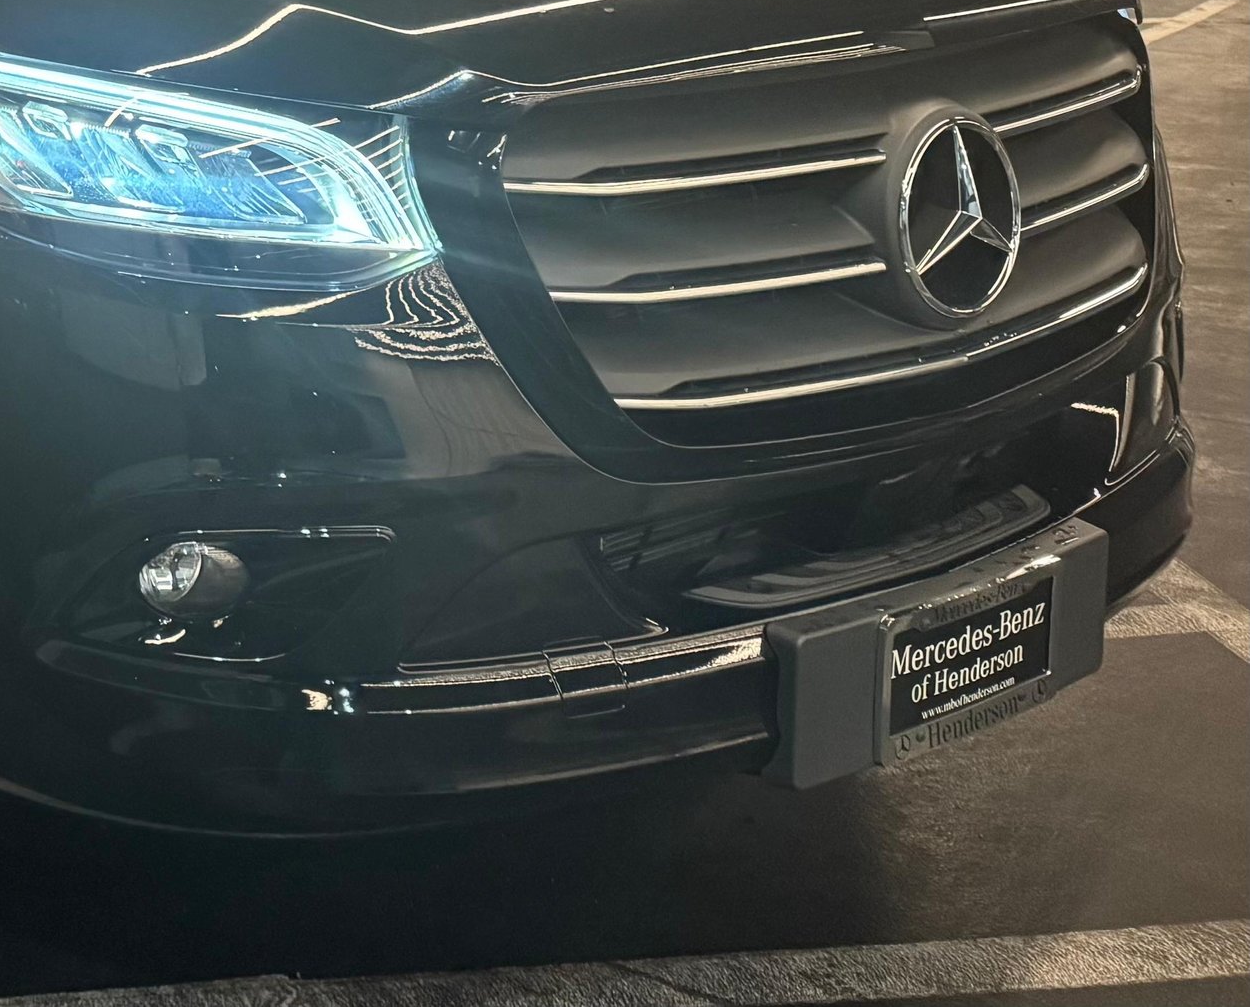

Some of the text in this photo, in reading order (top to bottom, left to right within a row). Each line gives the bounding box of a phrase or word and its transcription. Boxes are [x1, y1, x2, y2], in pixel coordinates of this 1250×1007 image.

[891, 602, 1046, 679] Mercedes-Benz
[911, 644, 1024, 703] of Henderson
[921, 676, 1015, 720] www.mbofhenderson.com
[927, 697, 1020, 748] Henderson
